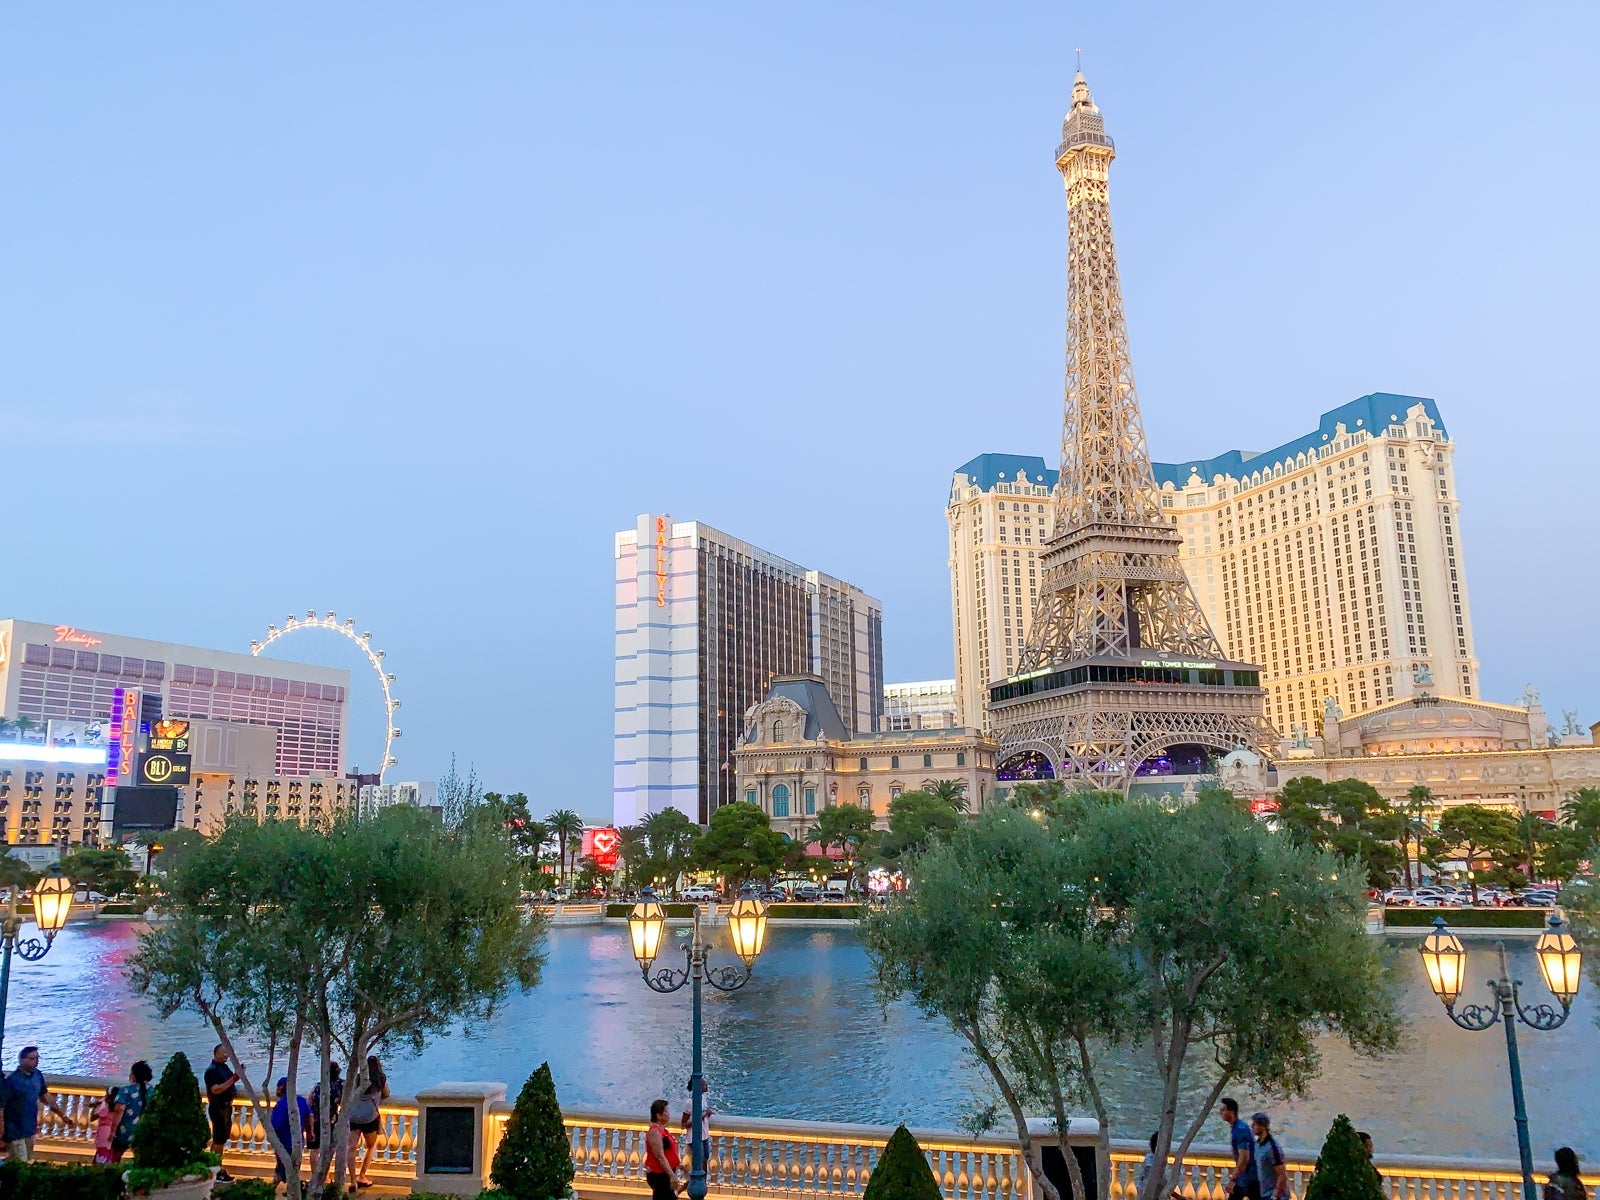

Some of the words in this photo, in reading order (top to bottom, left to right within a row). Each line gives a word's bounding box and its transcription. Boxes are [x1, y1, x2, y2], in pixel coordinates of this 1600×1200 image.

[656, 516, 667, 607] BALLYS
[54, 625, 102, 648] Flamingo
[121, 692, 136, 775] BALLYS
[150, 760, 167, 776] BLT
[172, 765, 187, 773] STEAK
